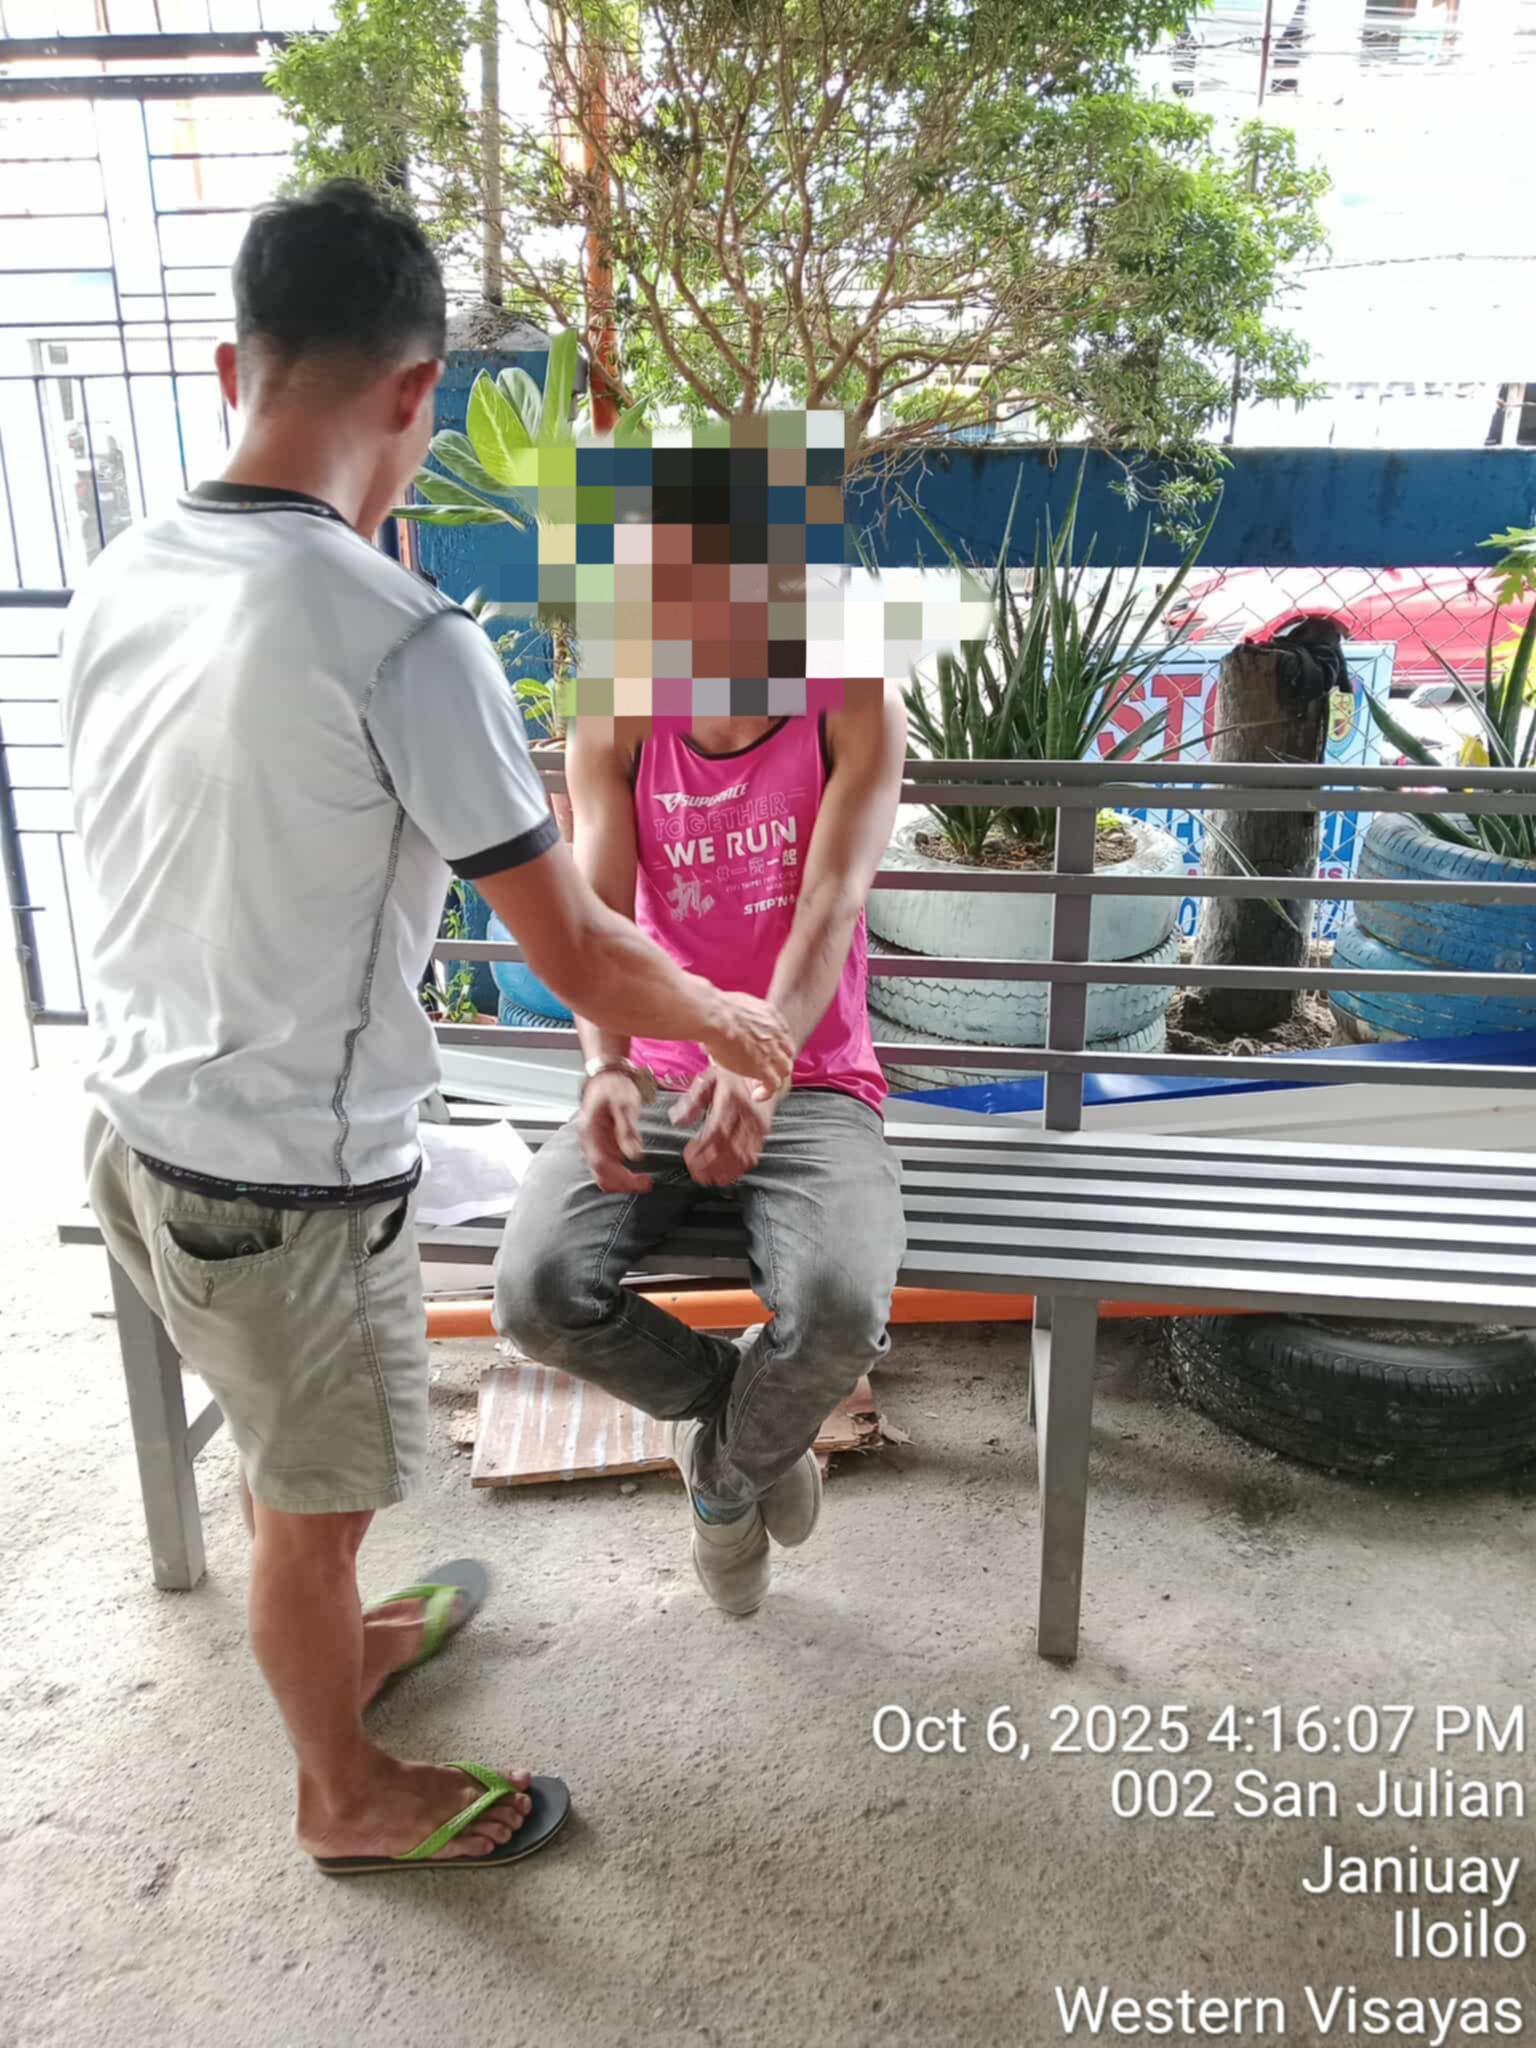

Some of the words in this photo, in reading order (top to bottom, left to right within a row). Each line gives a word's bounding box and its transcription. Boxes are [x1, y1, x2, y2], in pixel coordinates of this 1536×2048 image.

[653, 791, 789, 841] TOGETHER
[663, 836, 715, 869] WE
[726, 815, 798, 859] RUN
